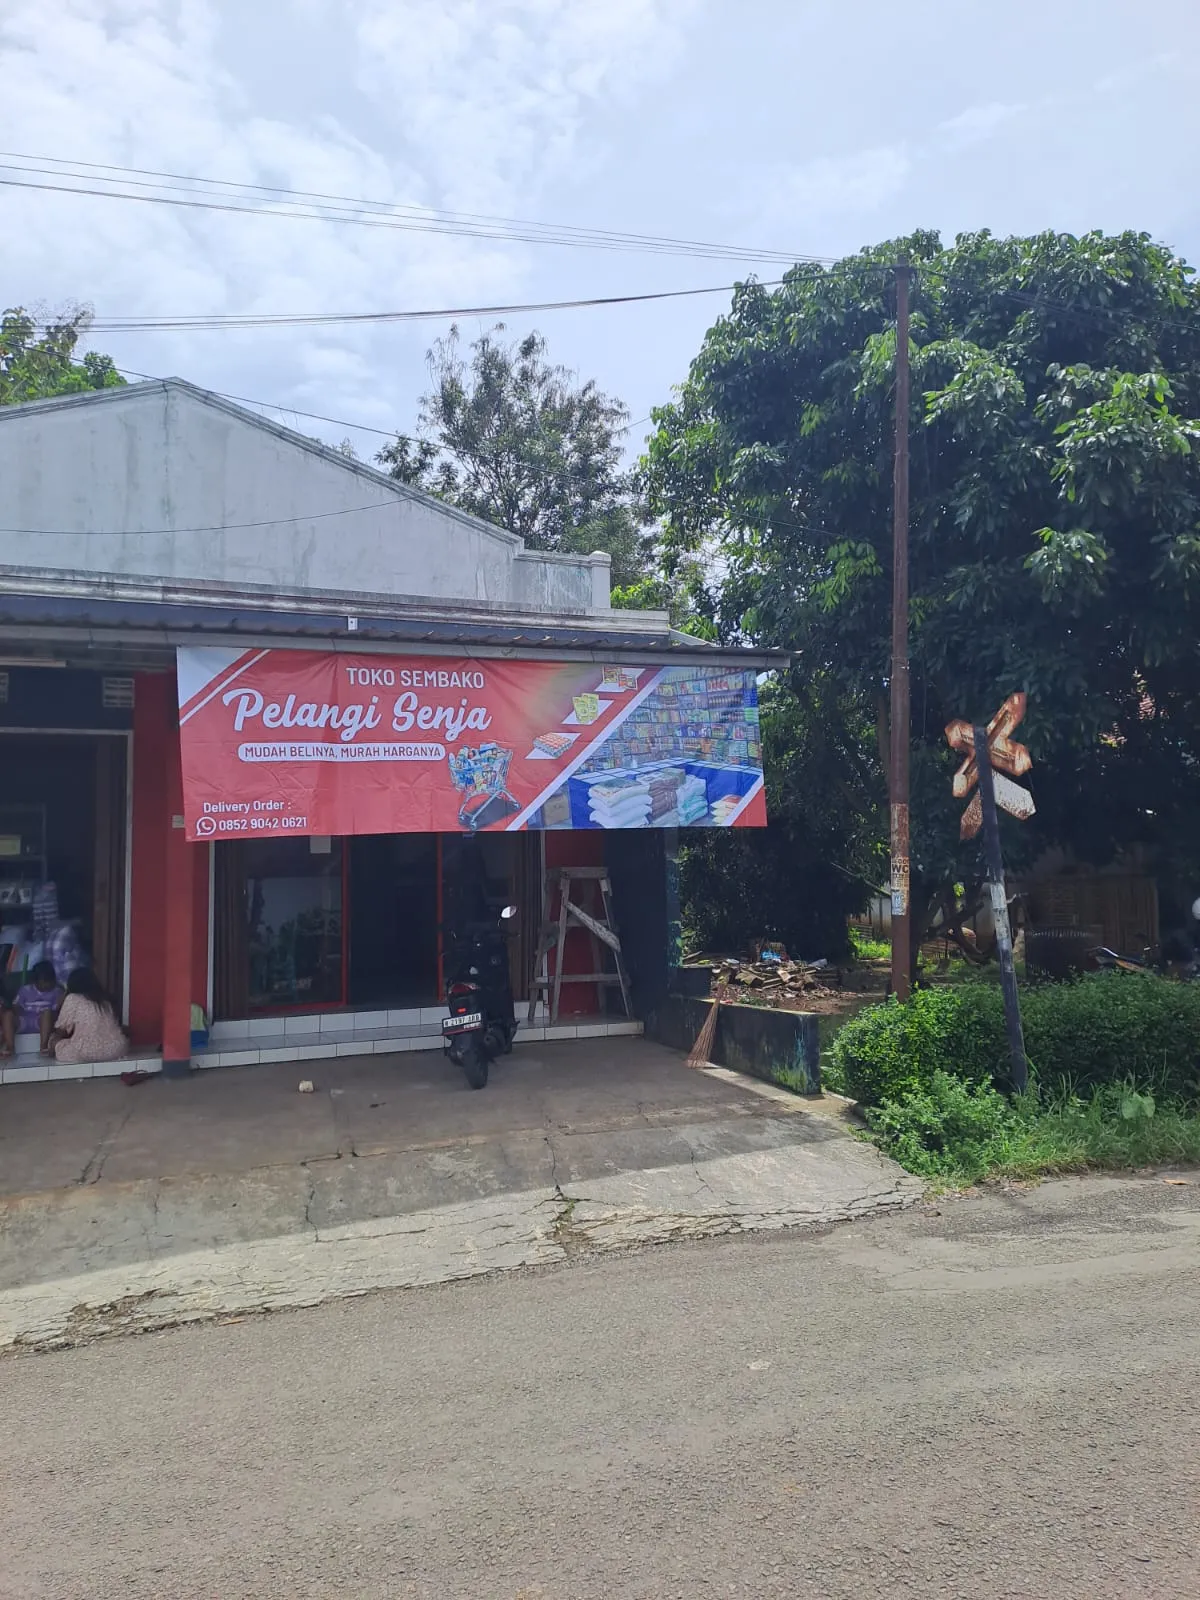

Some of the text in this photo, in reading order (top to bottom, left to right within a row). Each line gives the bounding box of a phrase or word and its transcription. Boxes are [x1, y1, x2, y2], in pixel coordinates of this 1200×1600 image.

[346, 667, 484, 689] TOKO SEMBAKO
[222, 687, 493, 742] Pelangi Senja
[244, 746, 441, 759] MUDAH BELINYA, MURAH HARGANYA
[203, 801, 250, 814] Delivery
[253, 800, 285, 811] Order
[218, 816, 307, 831] 0852 9042 0621
[891, 864, 909, 873] WC
